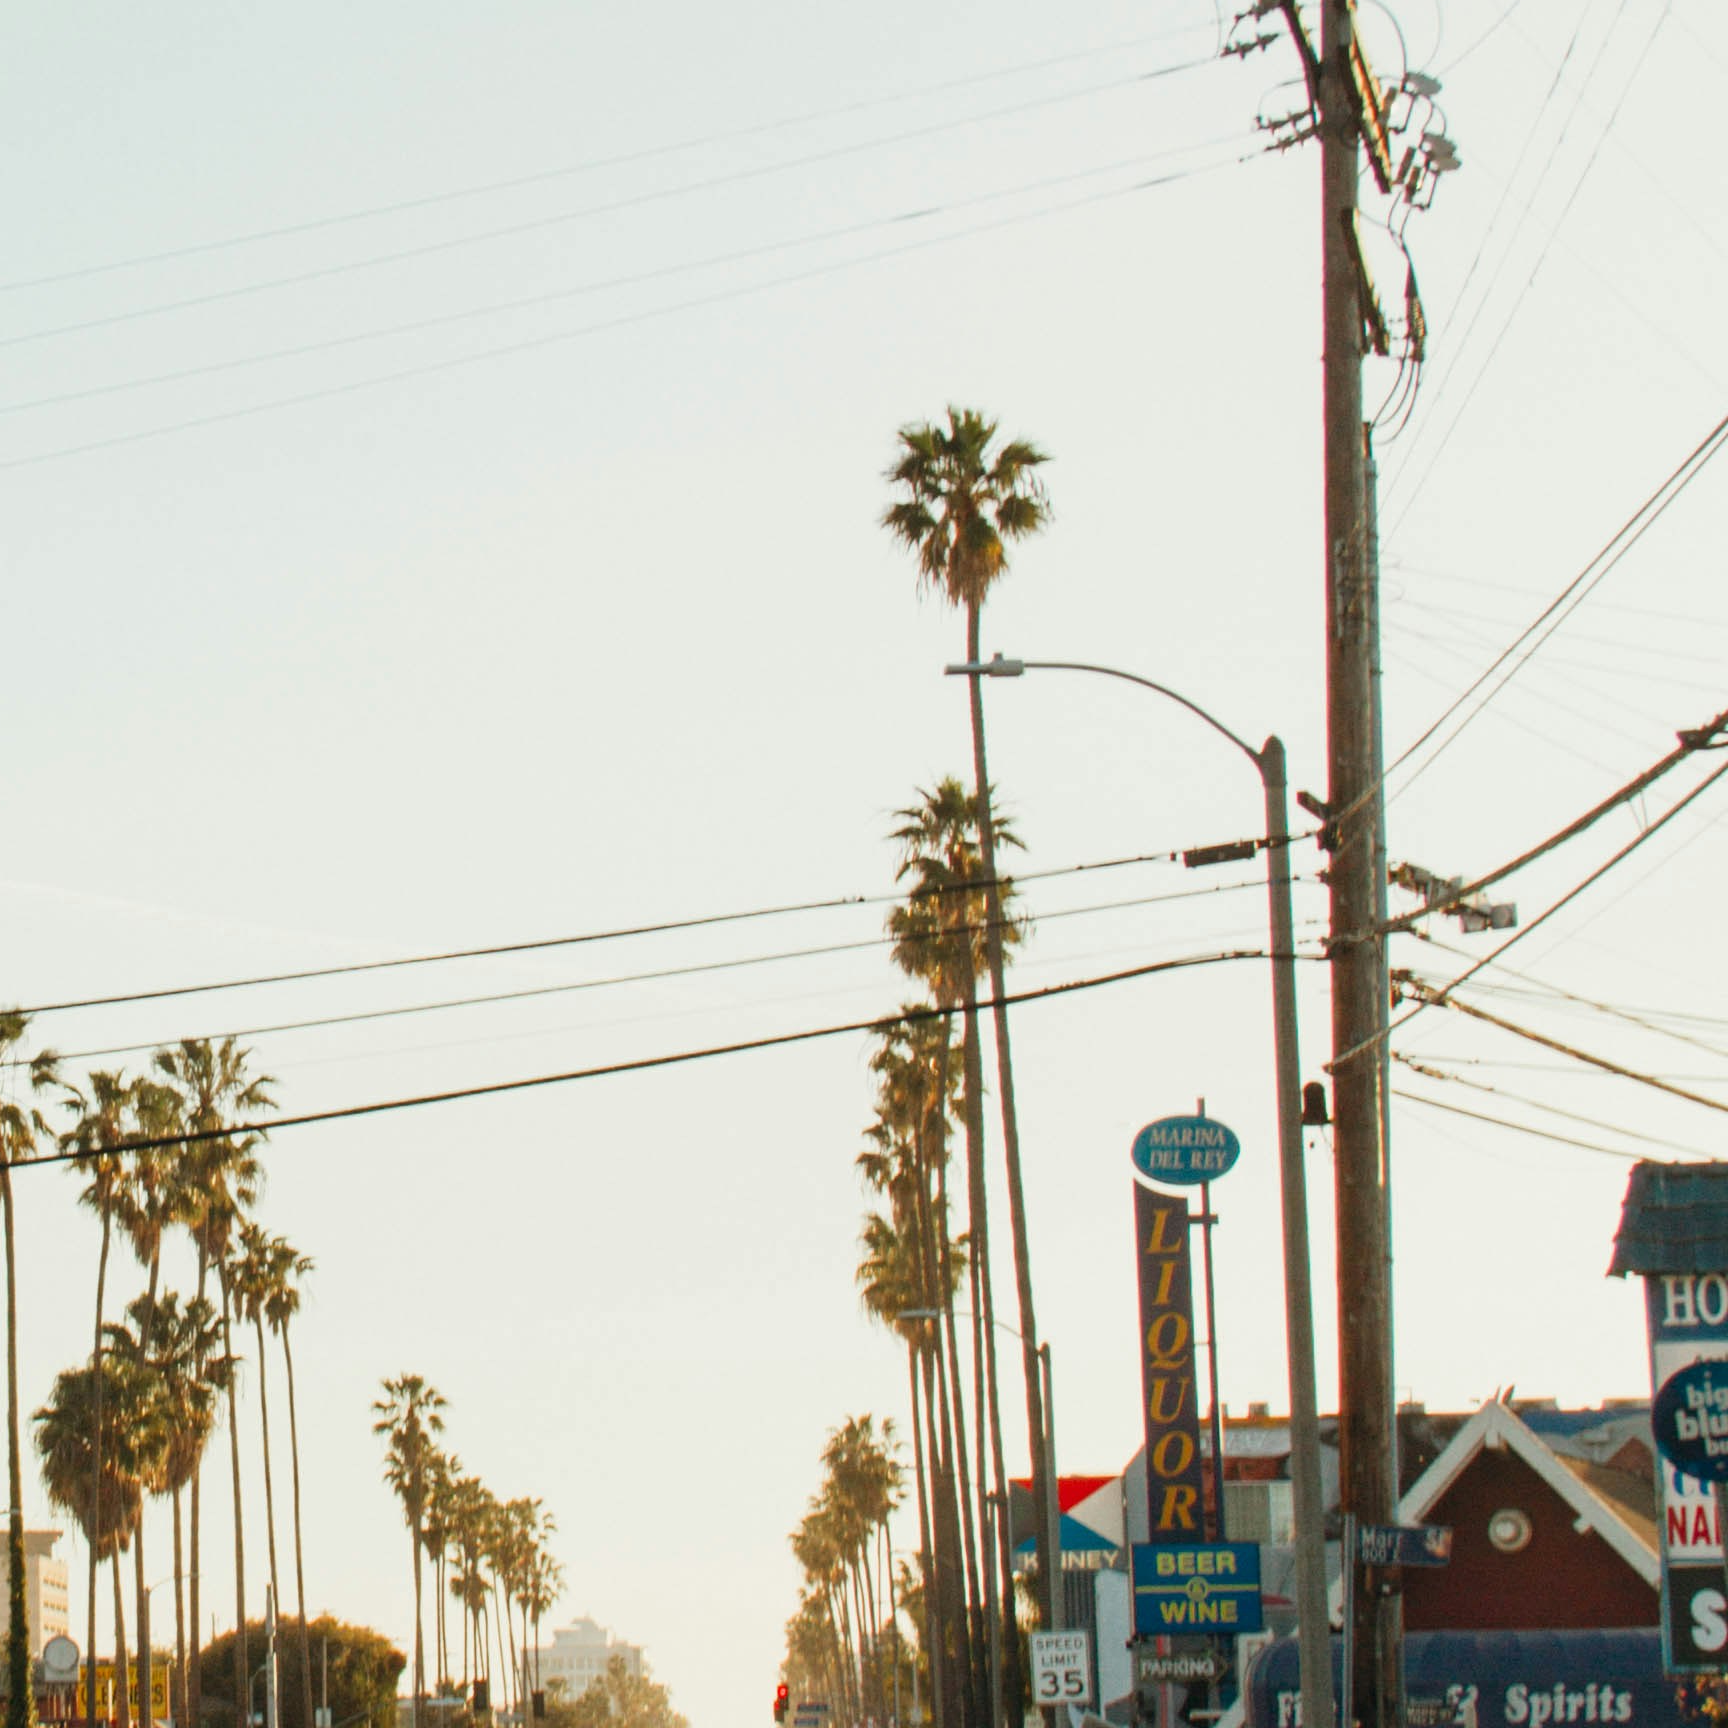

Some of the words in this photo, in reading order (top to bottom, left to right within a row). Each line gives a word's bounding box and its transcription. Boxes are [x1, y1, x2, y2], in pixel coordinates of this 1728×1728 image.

[1149, 1127, 1226, 1147] MARINA
[1149, 1150, 1184, 1169] DEL
[1190, 1150, 1227, 1170] REY
[1145, 1208, 1197, 1530] LIQUOR
[1024, 1550, 1119, 1569] KNEY
[1156, 1551, 1237, 1575] BEER
[1160, 1600, 1237, 1623] WINE
[1036, 1639, 1082, 1650] SPEED
[1041, 1654, 1077, 1667] LIMIT
[1040, 1670, 1083, 1696] 35
